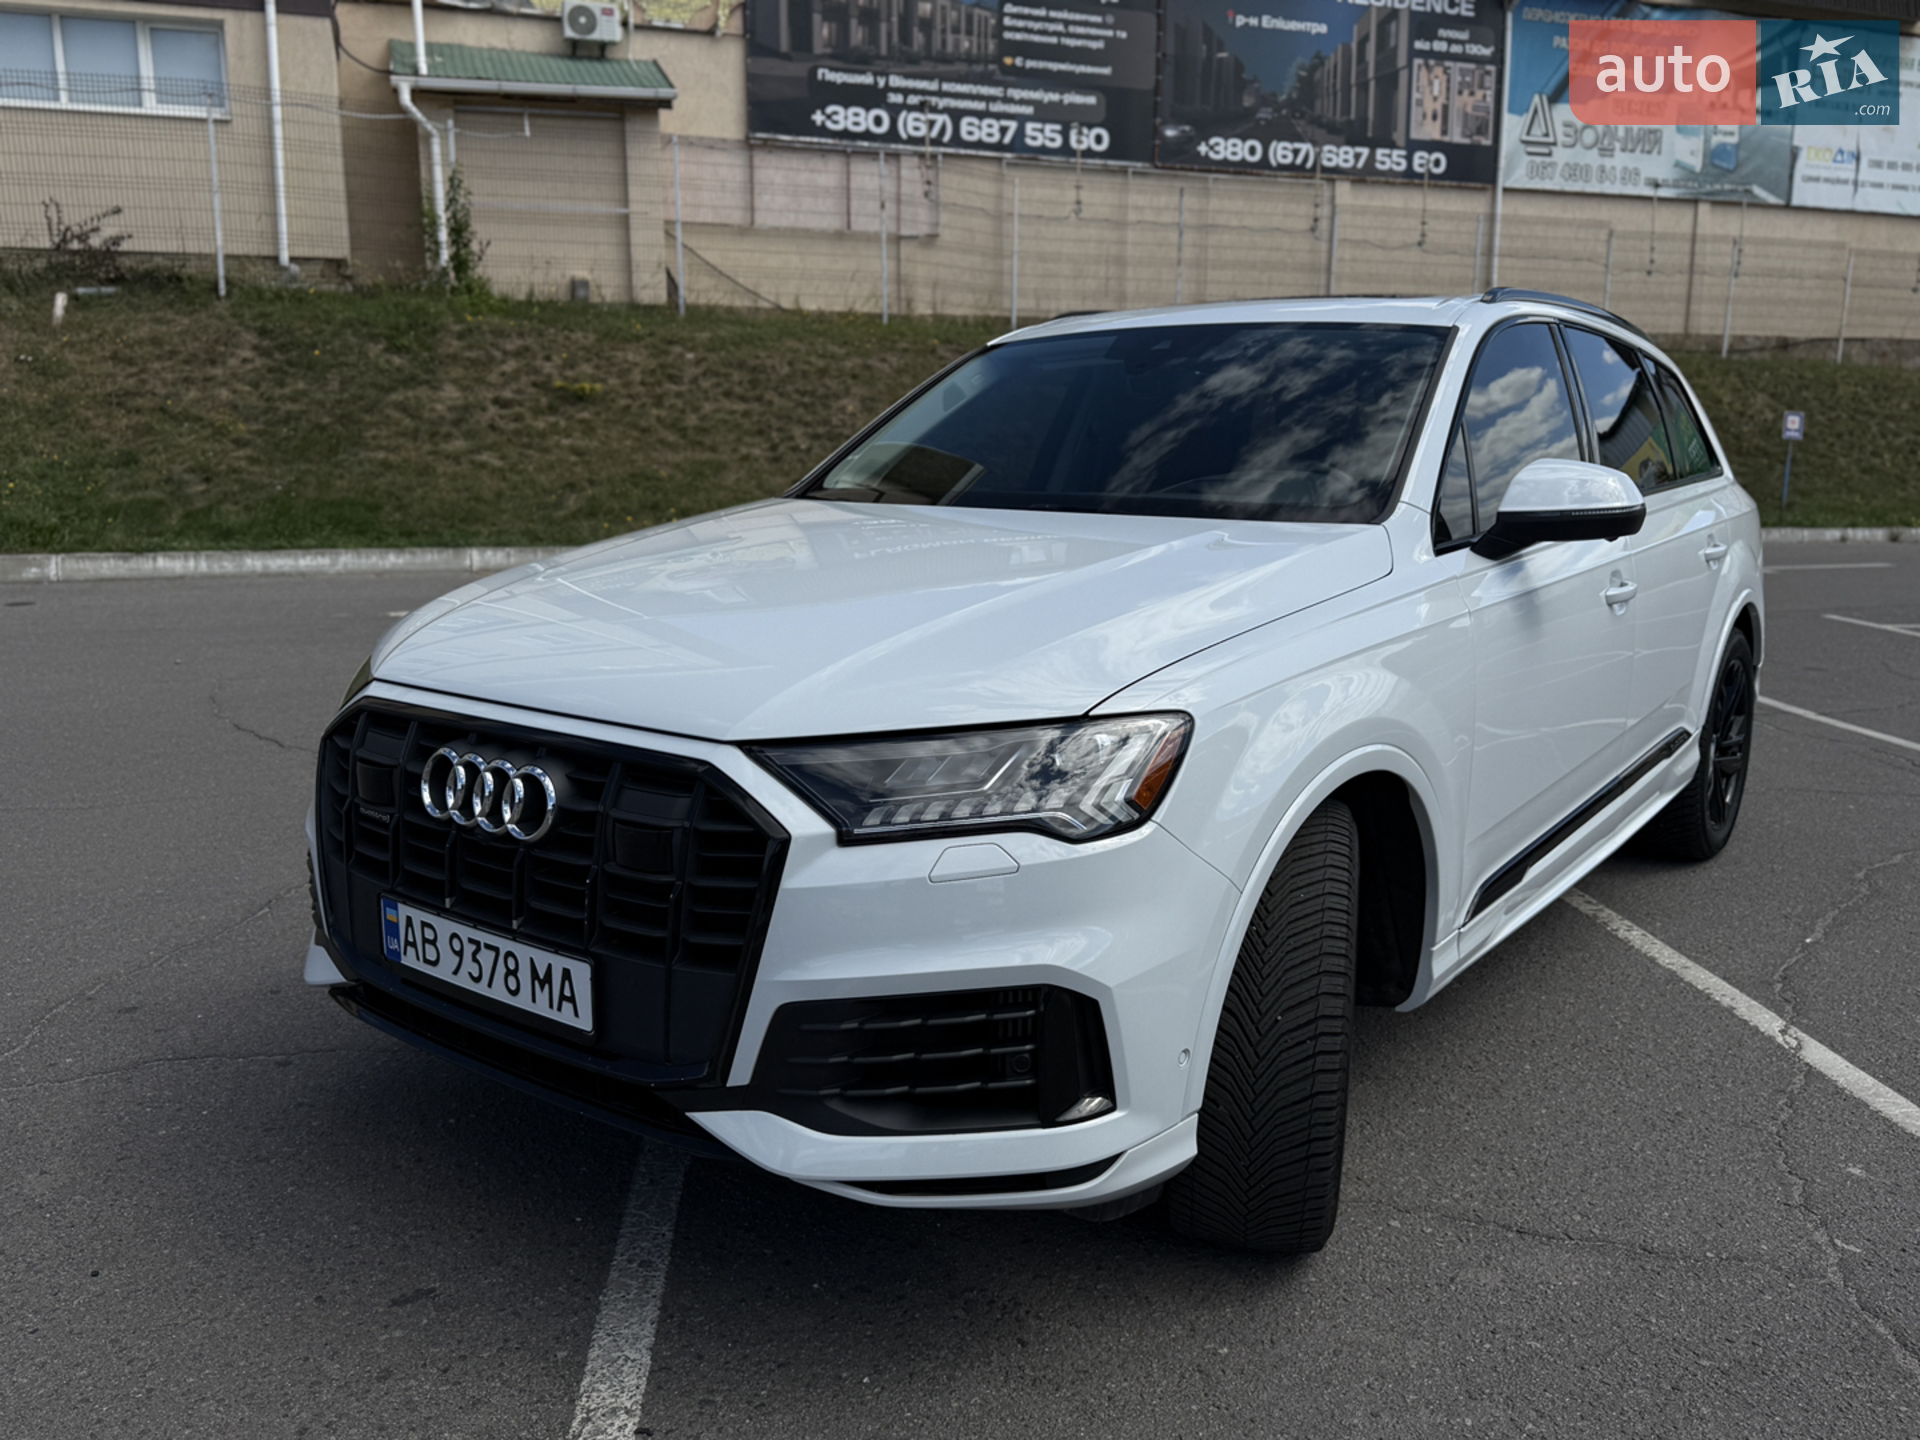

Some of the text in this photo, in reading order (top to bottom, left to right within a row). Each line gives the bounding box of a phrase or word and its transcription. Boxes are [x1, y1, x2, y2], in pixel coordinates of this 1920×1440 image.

[1235, 14, 1328, 35] р-н Епіцентра
[817, 68, 1097, 106] Перший у Вінниці комплекс преміум-рівня
[886, 92, 904, 104] за
[988, 100, 1034, 116] цінами
[810, 104, 1110, 153] +380 (67) 687 55 60
[1197, 136, 1448, 175] +380 (67) 687 55 60
[387, 935, 400, 952] UA
[403, 915, 579, 1018] AB 9378 MA
